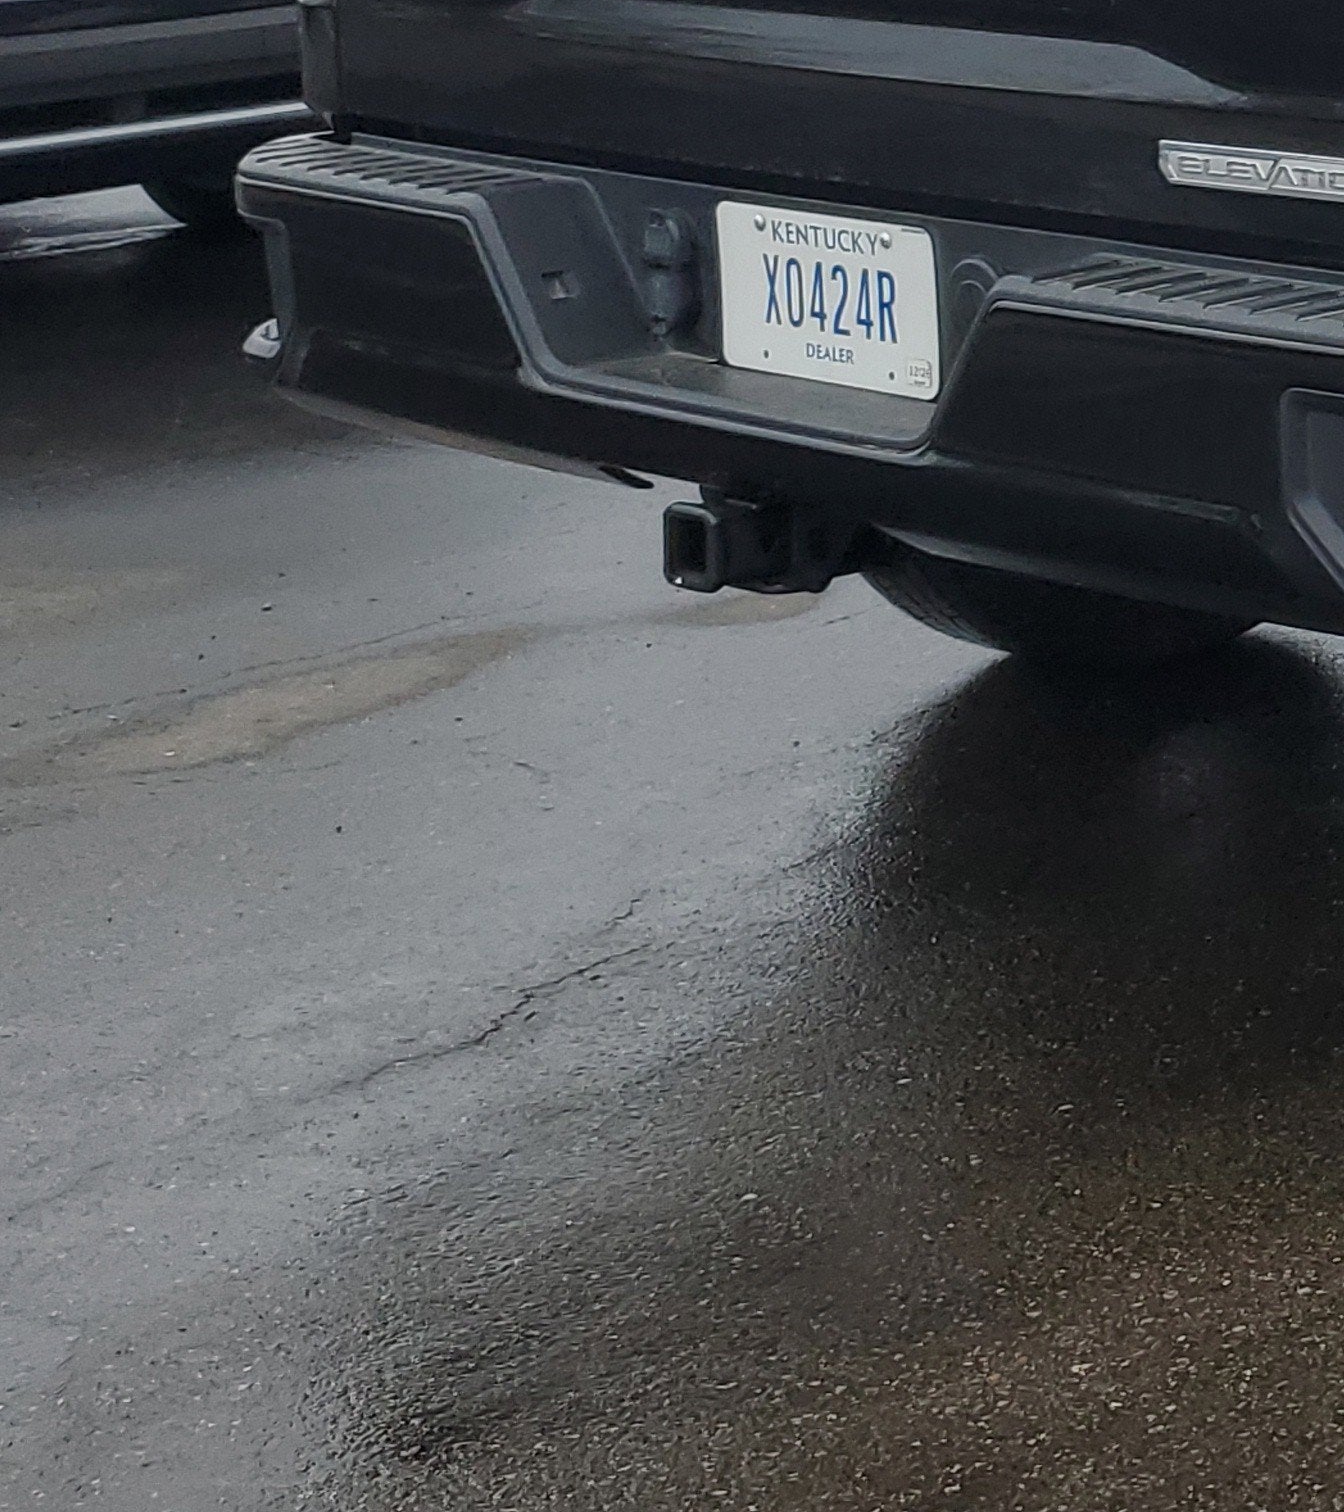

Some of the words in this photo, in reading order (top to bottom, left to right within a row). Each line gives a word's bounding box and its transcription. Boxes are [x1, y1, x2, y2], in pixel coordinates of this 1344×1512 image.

[771, 220, 878, 255] KENTUCKY
[763, 253, 897, 343] X0424R
[806, 342, 854, 364] DEALER
